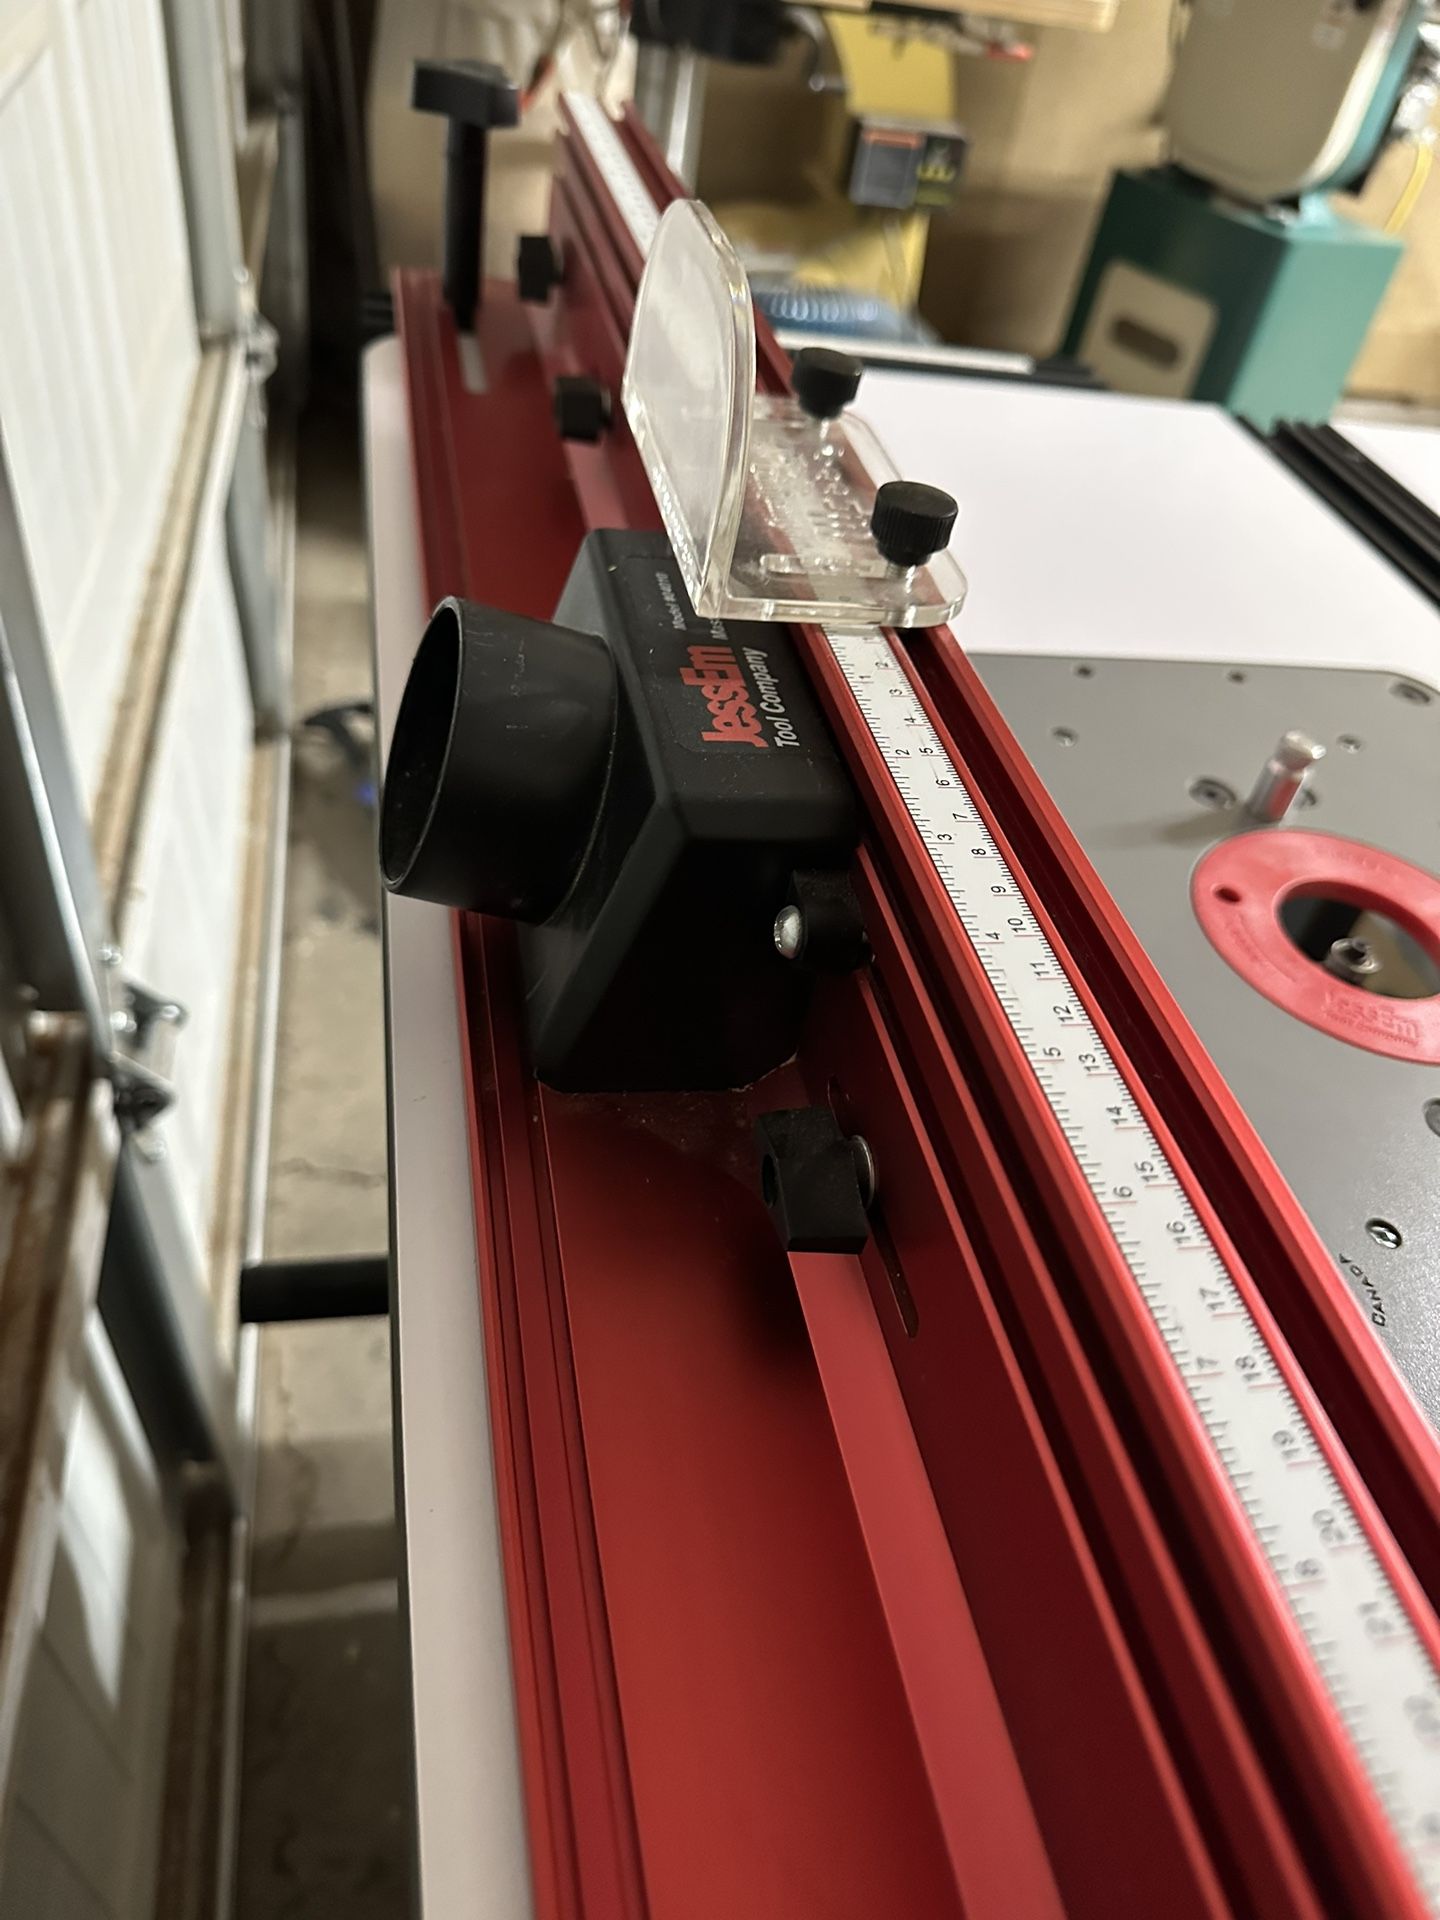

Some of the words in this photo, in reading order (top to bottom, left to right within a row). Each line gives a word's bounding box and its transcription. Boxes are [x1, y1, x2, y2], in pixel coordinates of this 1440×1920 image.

[742, 646, 787, 713] Company
[679, 645, 769, 748] JessEm
[889, 688, 903, 696] 3
[766, 715, 800, 748] Tool
[919, 747, 934, 755] 5
[952, 812, 968, 820] 7
[937, 833, 952, 841] 3
[971, 848, 987, 856] 8
[991, 885, 1007, 893] 9
[1007, 917, 1026, 933] 10
[985, 932, 1001, 940] 4
[1030, 963, 1050, 976] 11
[1053, 1005, 1074, 1023] 12
[1043, 1047, 1061, 1057] 5
[1078, 1053, 1100, 1072] 13
[1106, 1106, 1128, 1125] 14
[1135, 1160, 1158, 1182] 15
[1113, 1185, 1133, 1199] 6
[1166, 1220, 1191, 1243] 16
[1338, 1252, 1387, 1327] CANADA
[1199, 1287, 1226, 1311] 17
[1235, 1355, 1262, 1382] 18
